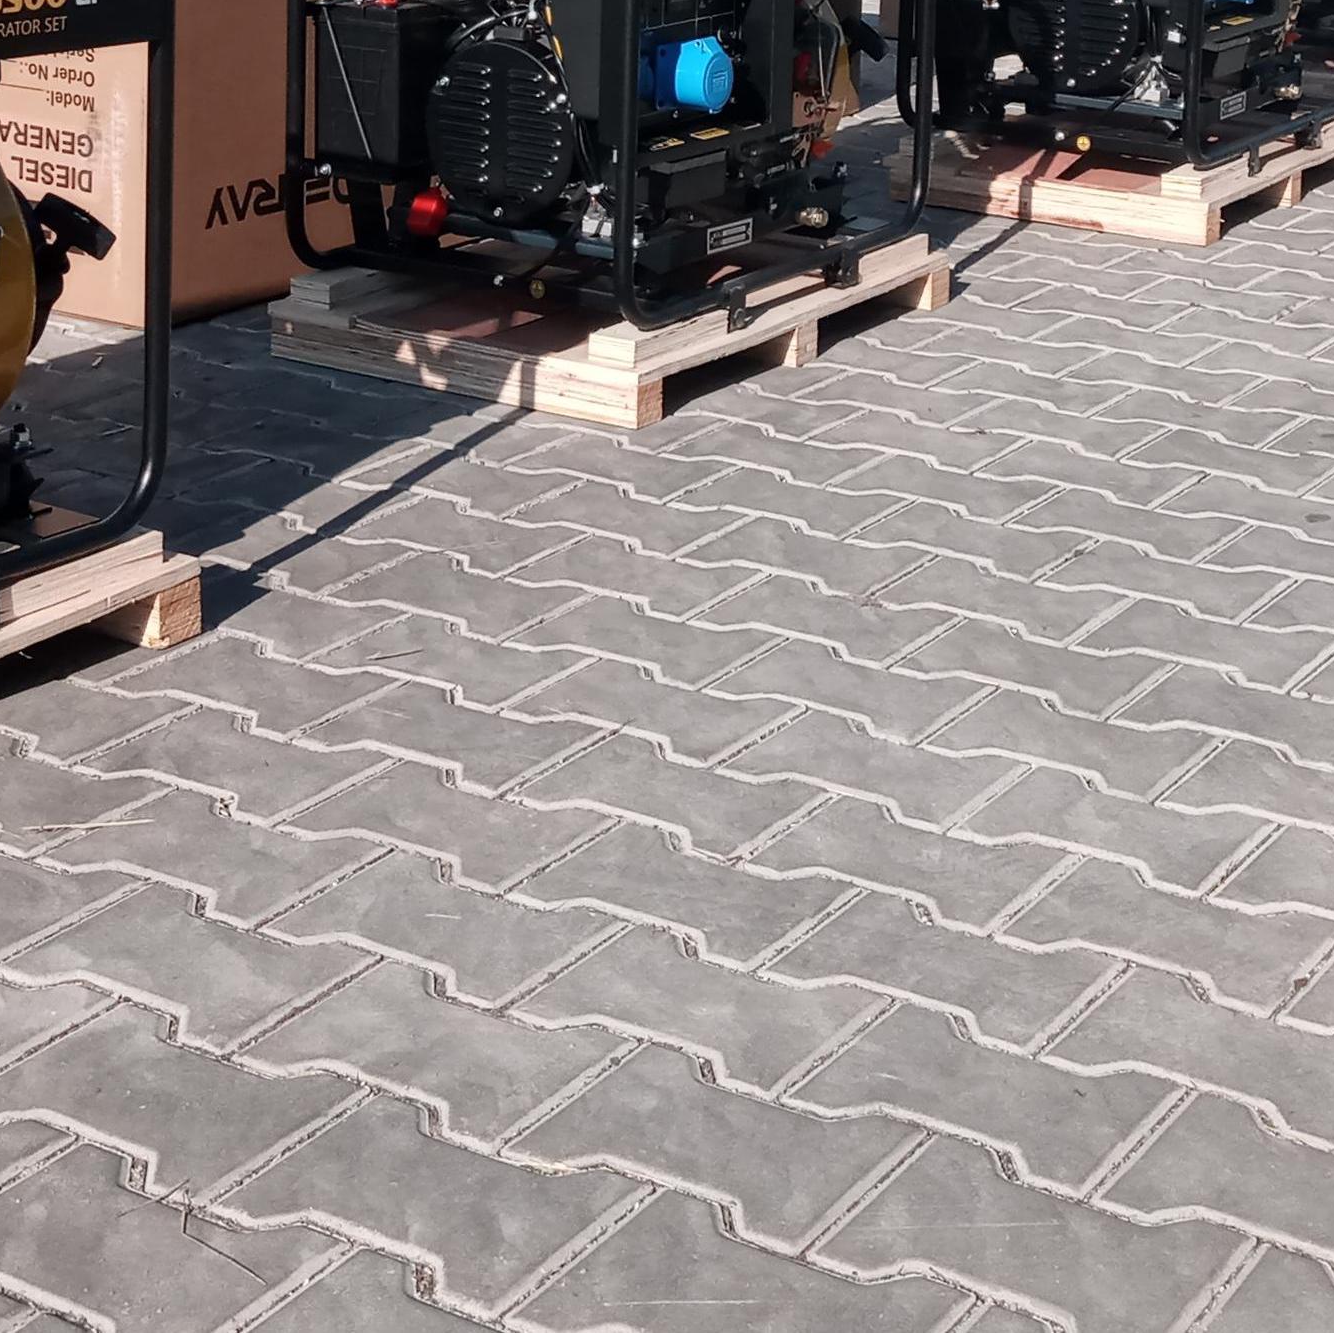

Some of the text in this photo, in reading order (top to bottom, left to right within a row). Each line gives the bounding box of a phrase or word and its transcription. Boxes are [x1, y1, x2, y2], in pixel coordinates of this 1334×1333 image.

[44, 15, 68, 33] SET
[52, 66, 95, 88] Order
[46, 89, 95, 113] Model:
[10, 155, 93, 194] DIESEL
